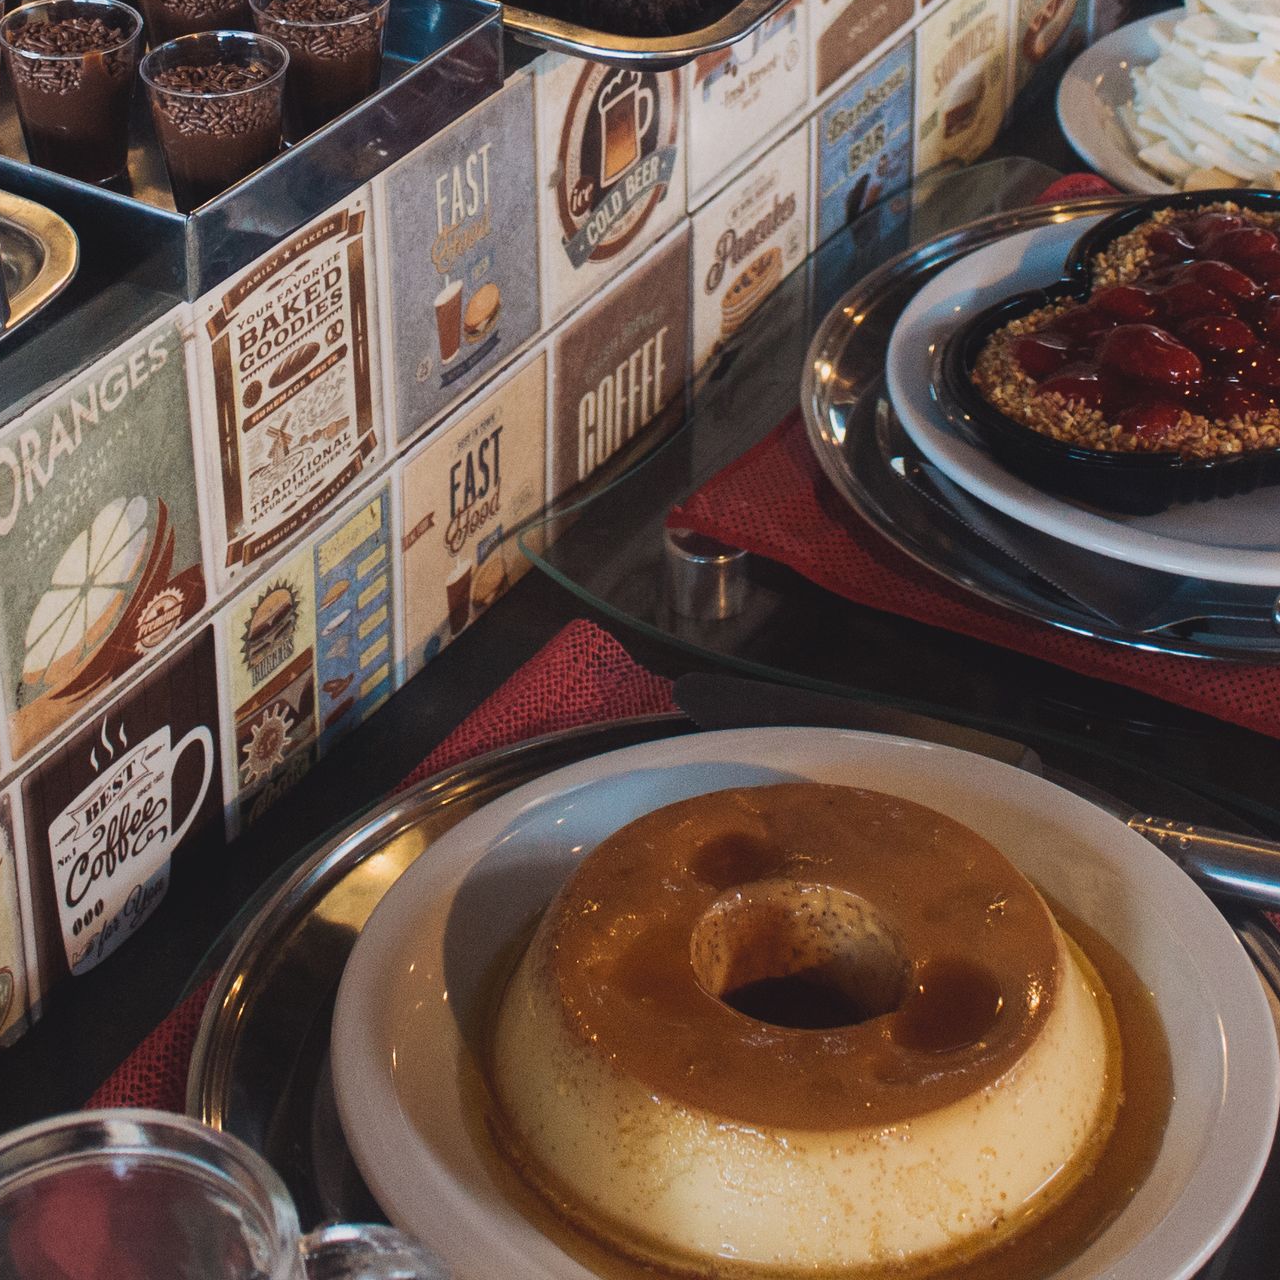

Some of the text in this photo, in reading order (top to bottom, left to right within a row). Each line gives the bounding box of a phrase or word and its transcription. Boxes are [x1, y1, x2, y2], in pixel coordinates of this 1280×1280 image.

[435, 141, 493, 236] FAST
[849, 122, 886, 175] BAR
[586, 191, 623, 246] COLD
[624, 155, 661, 201] BEER
[236, 251, 341, 331] YOUR FAVORITE
[238, 222, 336, 295] FAMILY BAKERS
[237, 265, 343, 357] BAKED
[239, 287, 344, 373] GOODIES
[251, 353, 340, 424] HOMEMADE TASTE
[577, 325, 669, 483] COFFEE
[250, 431, 352, 515] TRADITIONAL
[251, 440, 352, 524] NATURAL INGREDIENTS
[253, 470, 353, 555] PREMIUM QUALITY
[449, 424, 504, 520] FAST
[444, 476, 502, 557] Food
[140, 607, 182, 637] Premium
[84, 758, 137, 827] BEST
[65, 795, 168, 908] Coffee
